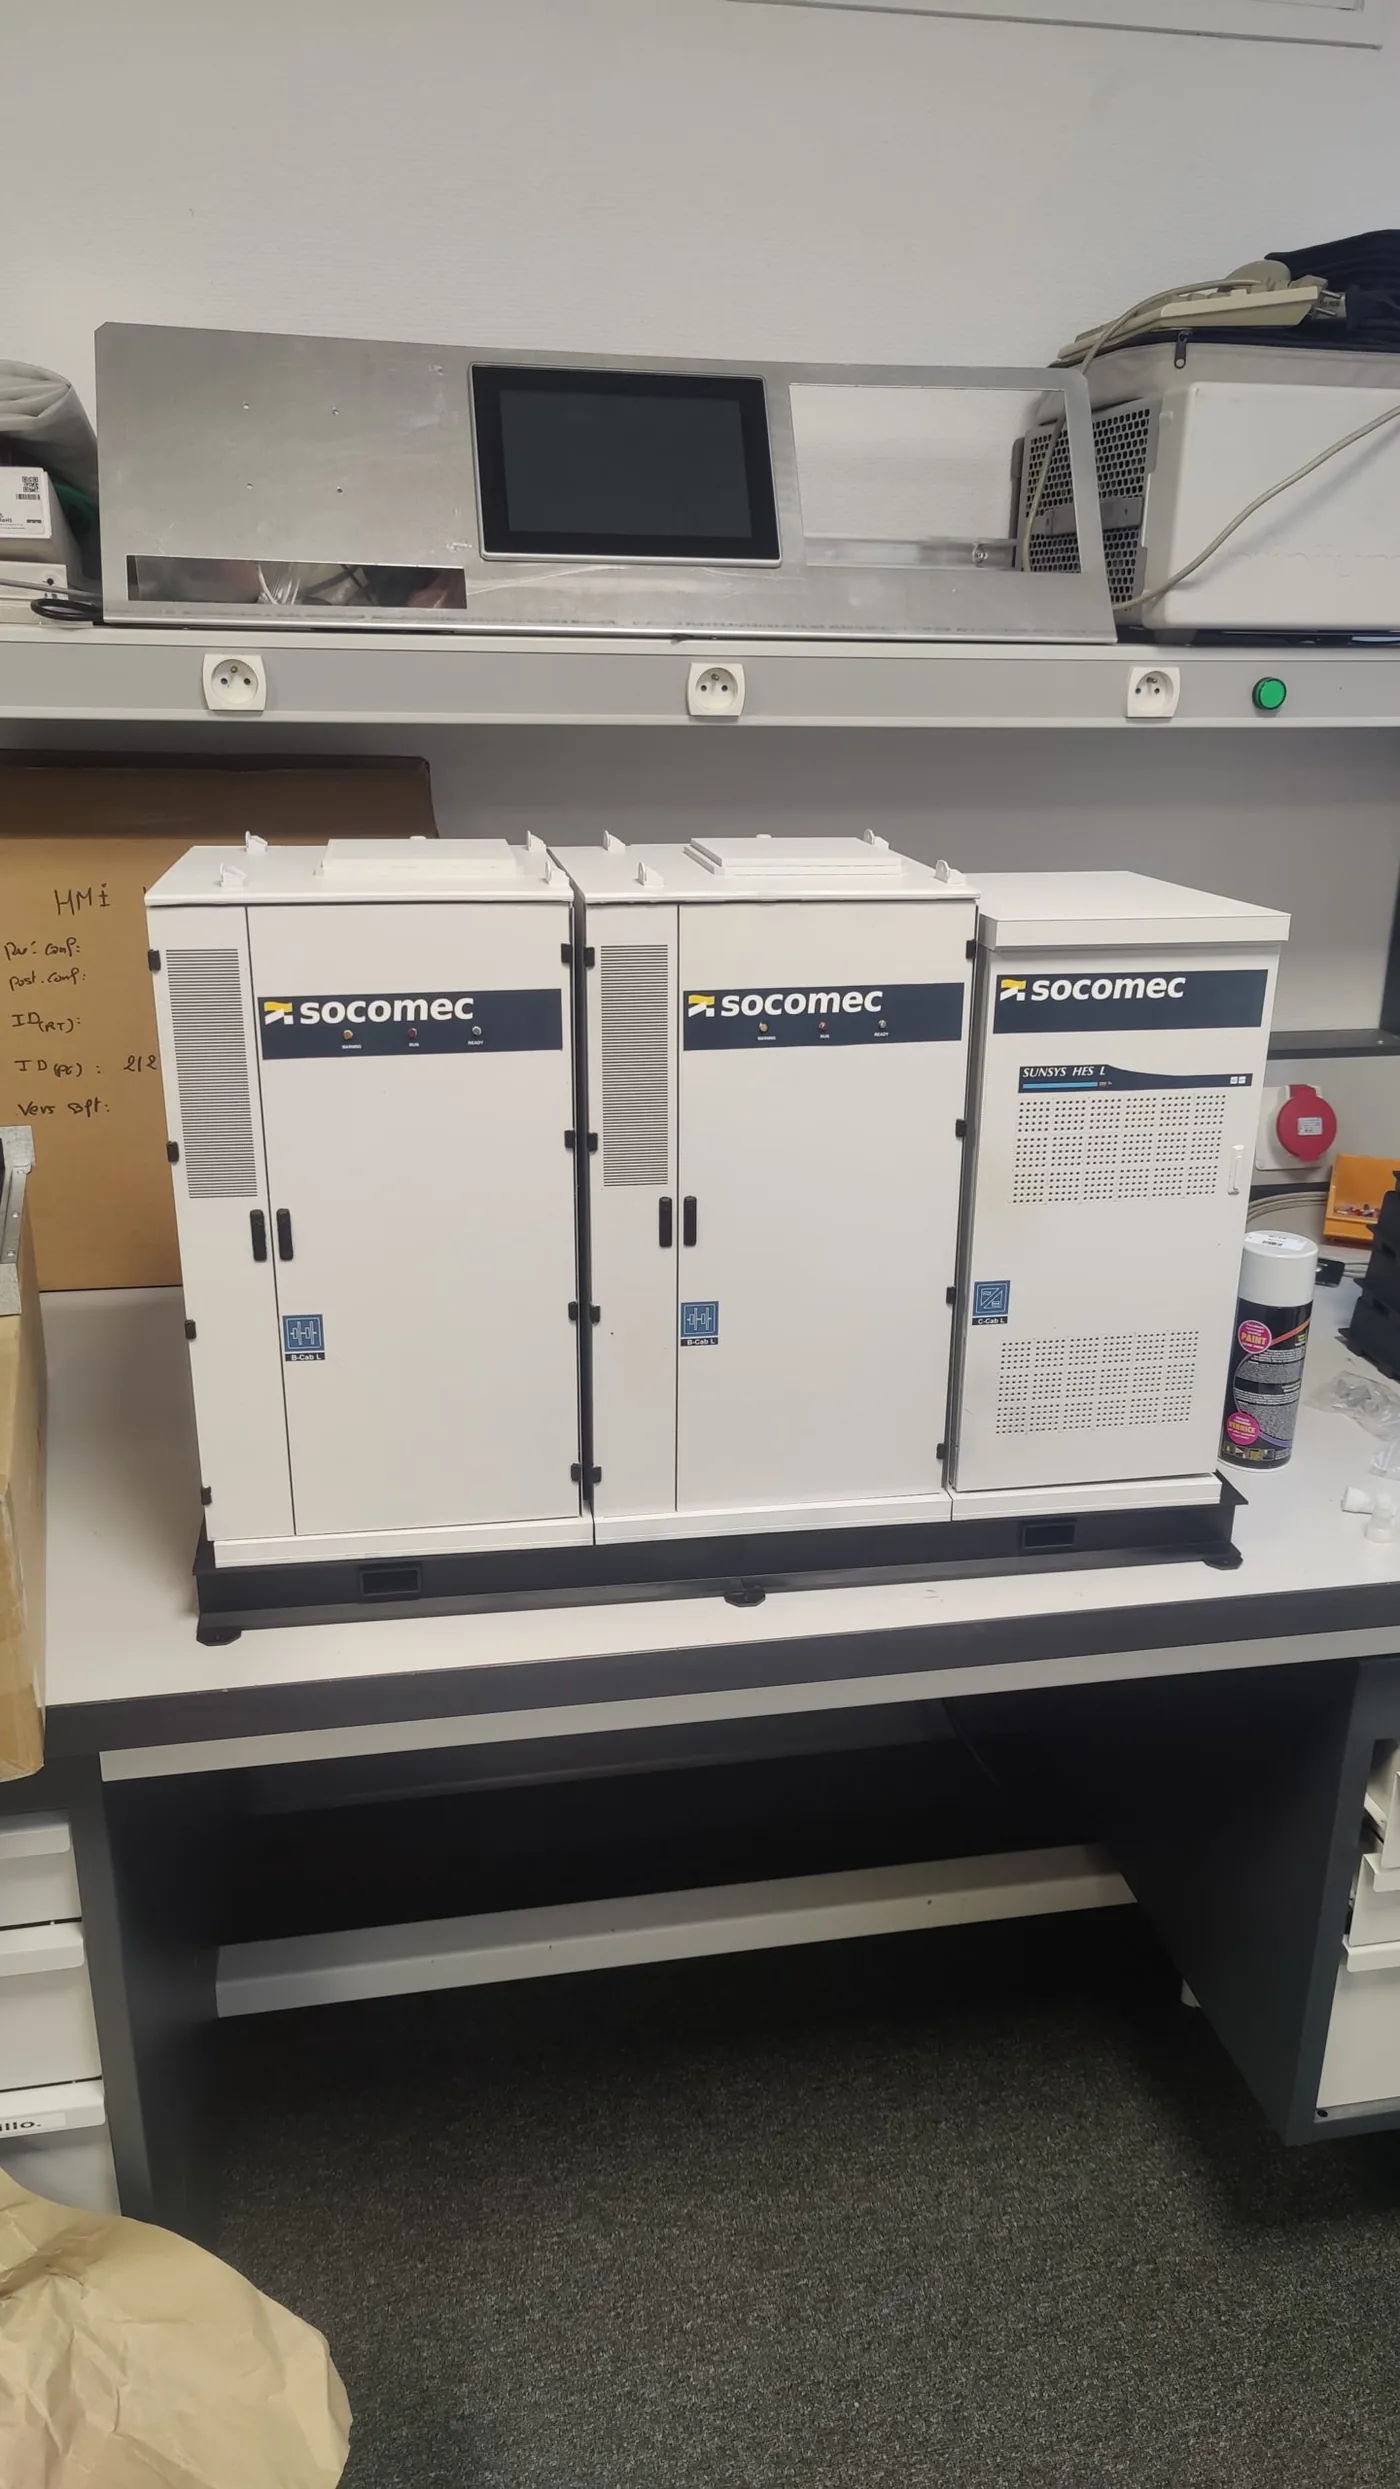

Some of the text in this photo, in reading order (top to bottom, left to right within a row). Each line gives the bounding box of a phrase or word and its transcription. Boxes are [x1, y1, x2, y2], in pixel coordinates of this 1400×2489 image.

[1031, 976, 1186, 1001] socomec
[299, 997, 474, 1025] socomec
[720, 990, 883, 1017] socomec
[1022, 1066, 1106, 1078] SUNSYS HES L
[1240, 1332, 1267, 1345] PAINT
